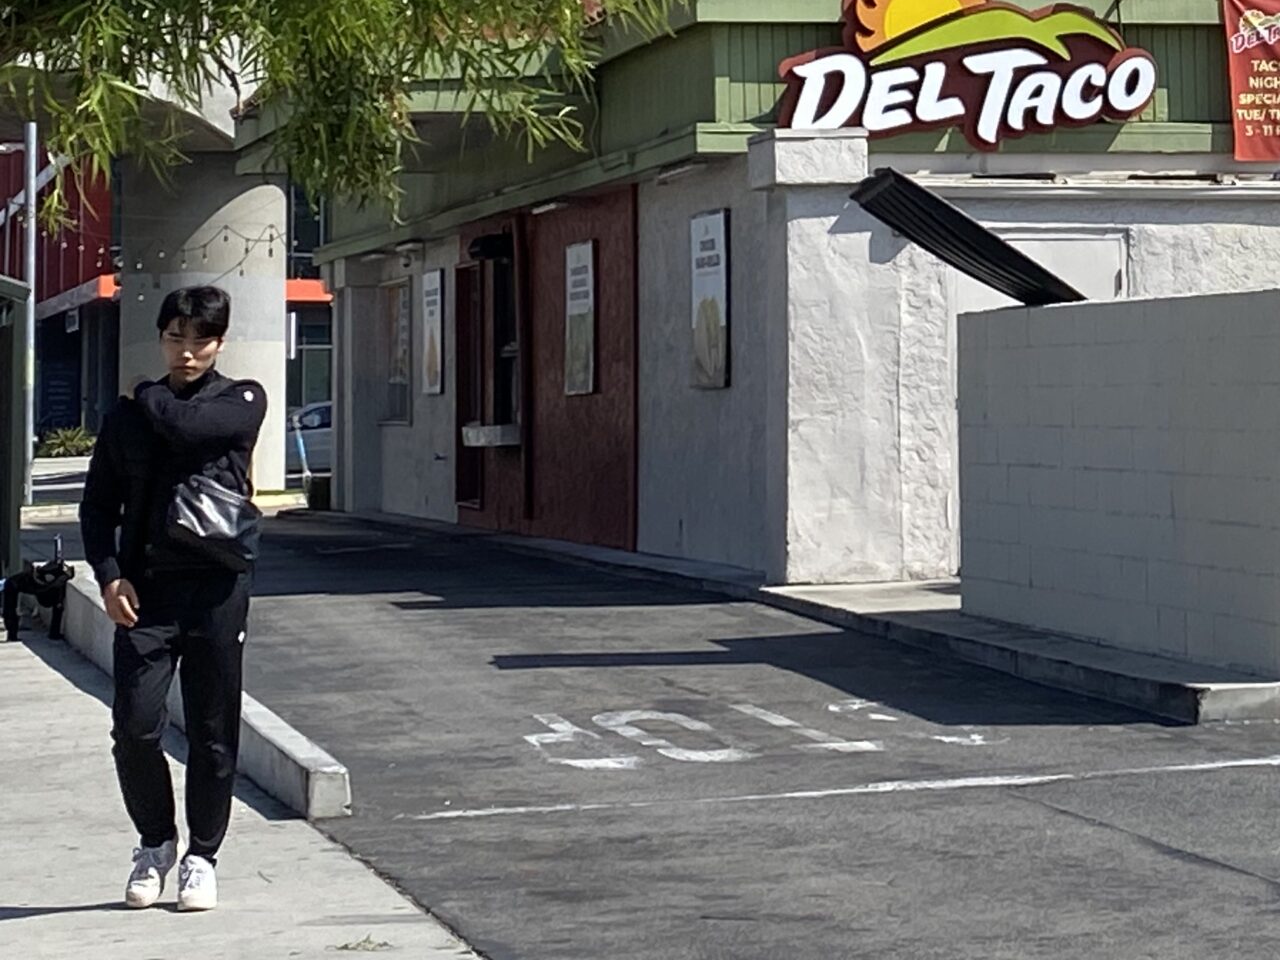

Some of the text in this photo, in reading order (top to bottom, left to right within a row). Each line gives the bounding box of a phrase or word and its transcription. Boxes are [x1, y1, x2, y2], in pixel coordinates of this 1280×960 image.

[1231, 29, 1264, 54] DEL
[791, 48, 1157, 145] DEL TACO
